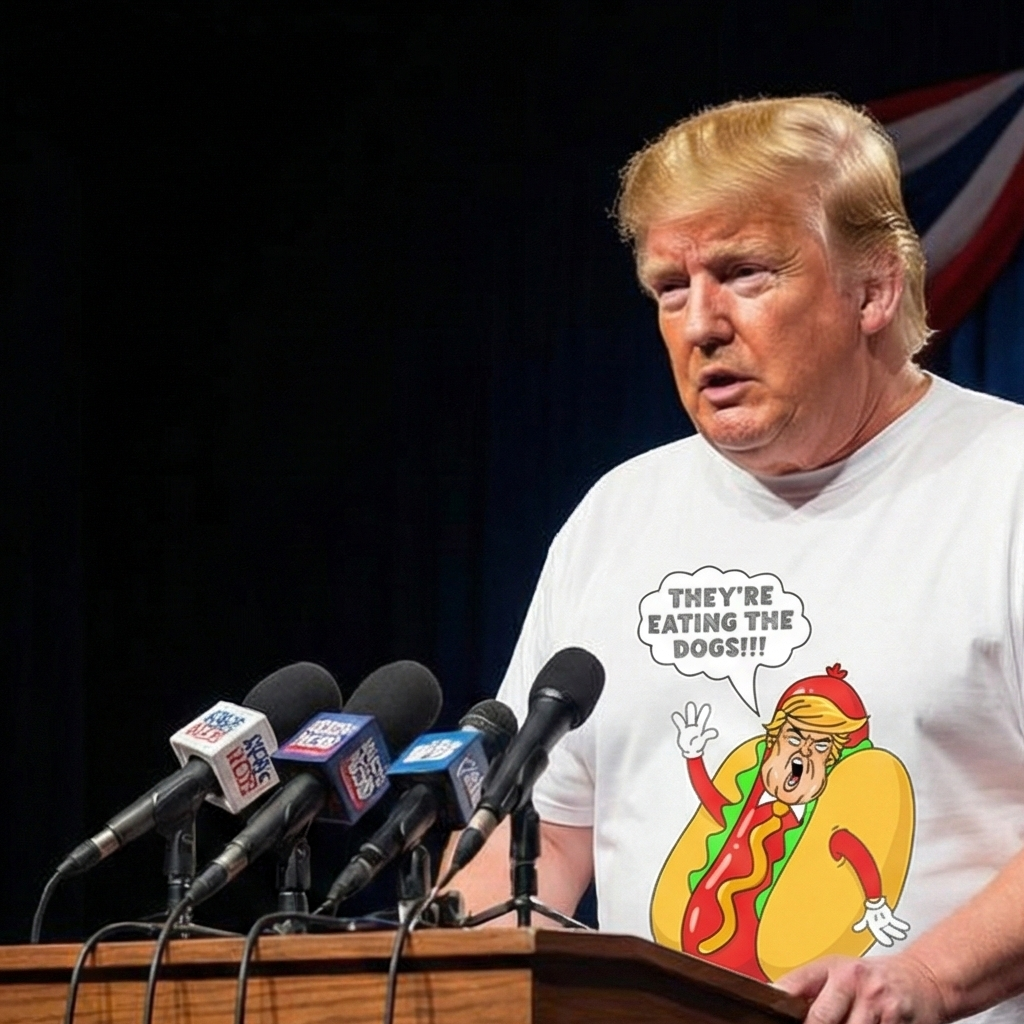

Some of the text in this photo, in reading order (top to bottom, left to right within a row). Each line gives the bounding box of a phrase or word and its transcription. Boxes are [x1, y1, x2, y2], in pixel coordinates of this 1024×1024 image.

[668, 585, 774, 608] THEY'RE
[648, 610, 794, 634] EATING THE
[673, 636, 766, 659] DOGS!!!
